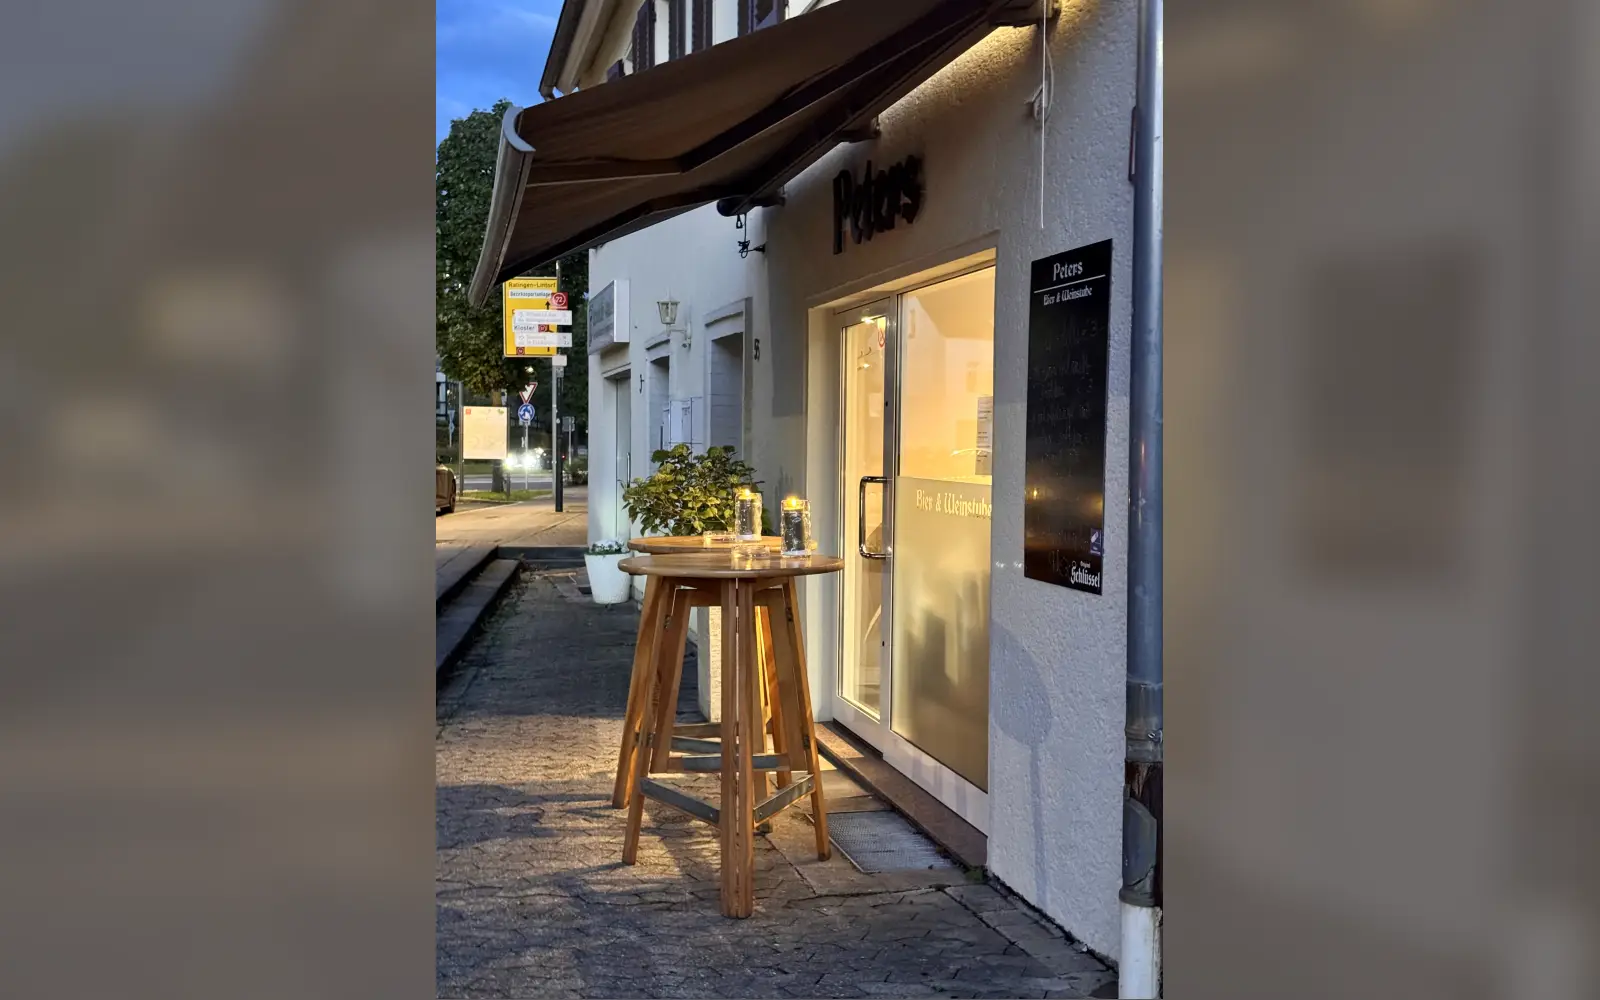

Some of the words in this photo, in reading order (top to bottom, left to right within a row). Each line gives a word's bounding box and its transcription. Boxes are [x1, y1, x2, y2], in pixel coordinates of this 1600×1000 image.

[833, 154, 922, 254] Peters
[1053, 261, 1083, 281] Peters
[1043, 294, 1056, 306] Bier
[1061, 285, 1093, 301] Weinstube
[916, 489, 933, 511] Bier
[935, 492, 942, 512] &
[944, 492, 992, 517] Weinstube
[1070, 560, 1100, 588] Schlüssel
